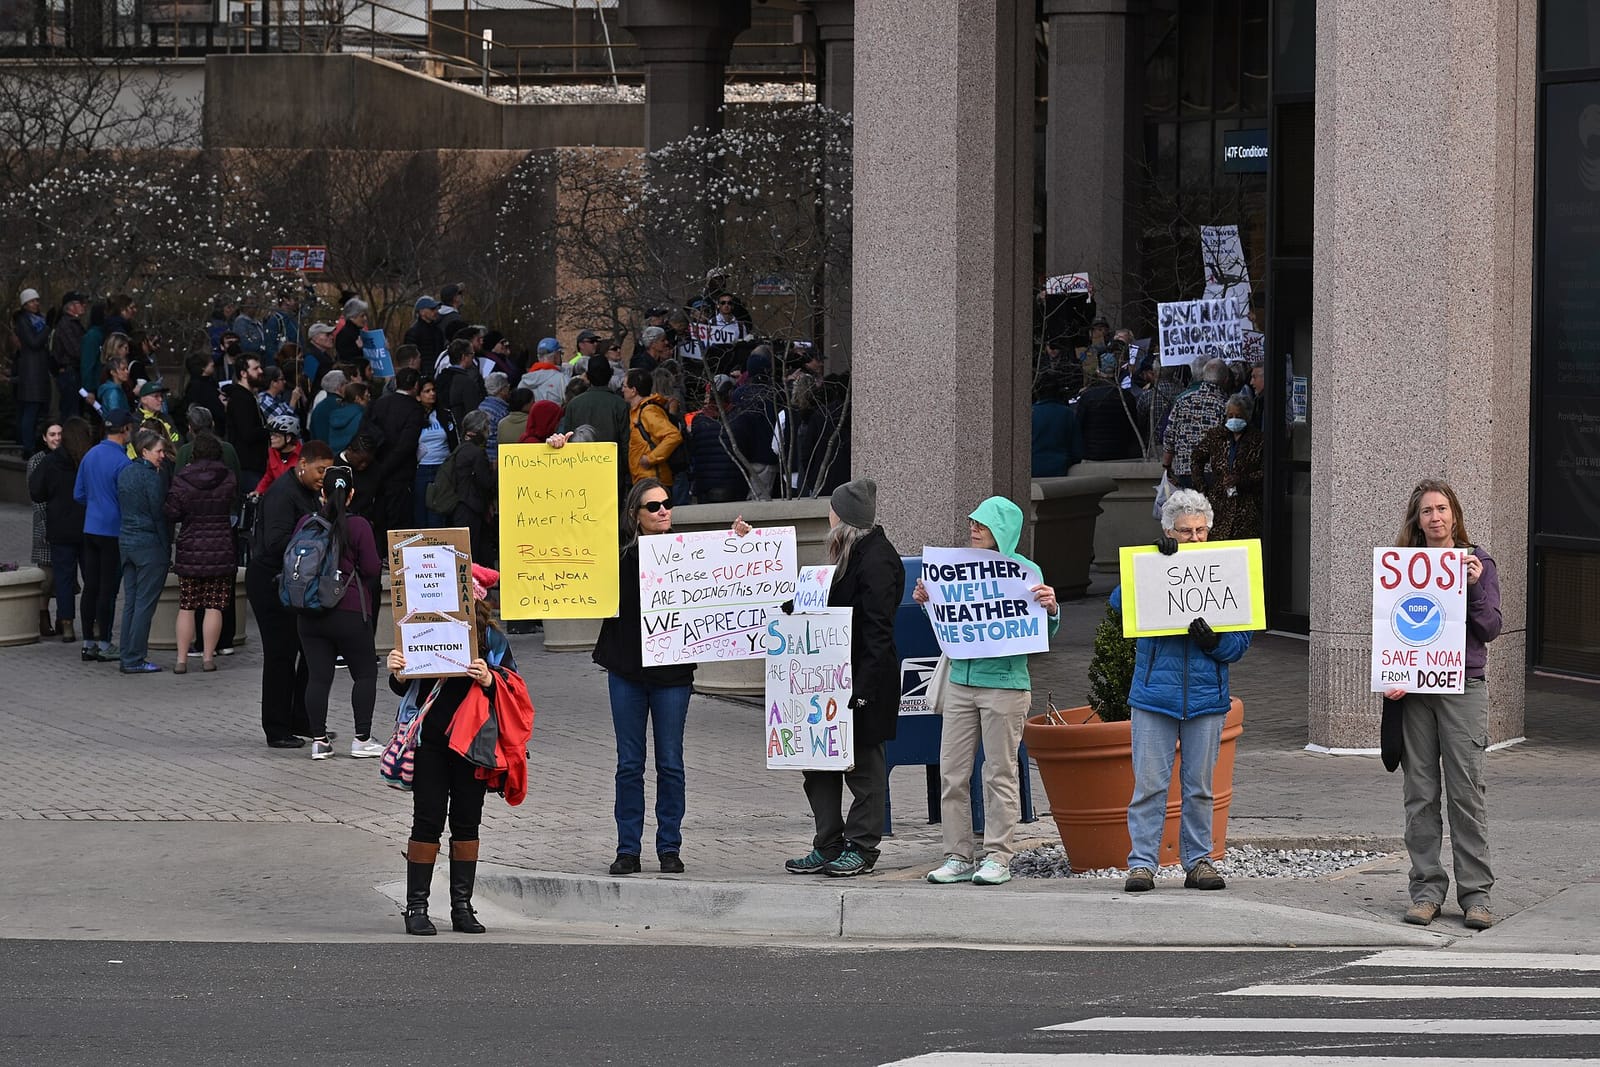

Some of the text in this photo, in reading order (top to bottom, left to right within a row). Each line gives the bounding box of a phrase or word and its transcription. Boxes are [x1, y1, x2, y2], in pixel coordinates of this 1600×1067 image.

[1161, 304, 1197, 328] SAVE
[714, 329, 735, 343] OUT
[1163, 323, 1242, 347] IGNORANCE
[1178, 345, 1195, 356] NOT
[1197, 345, 1203, 355] A
[517, 486, 587, 509] Making
[517, 511, 597, 528] Amerika
[516, 544, 596, 558] Russia
[651, 538, 783, 566] We're Sorry
[556, 571, 589, 581] NOAA
[665, 568, 708, 584] These
[711, 559, 784, 584] FUCKERS
[800, 570, 813, 584] WE
[922, 560, 1027, 582] TOGETHER,
[1166, 564, 1222, 586] SAVE
[1380, 551, 1464, 595] SOS!
[651, 590, 676, 608] ARE
[682, 583, 729, 605] DOING
[940, 580, 1005, 603] WE'LL
[1168, 586, 1238, 616] NOAA
[520, 595, 598, 612] Oligarchs
[933, 599, 1030, 623] WEATHER
[644, 609, 767, 646] WE APPRECIA
[934, 617, 1039, 644] THE STORM
[408, 643, 463, 652] EXTINCTION!
[1381, 649, 1462, 667] SAVE NOAA
[768, 658, 852, 695] ARE RISING
[1381, 670, 1463, 691] FROM DOGE!
[769, 694, 838, 726] AND SO
[767, 720, 849, 759] ARE WE!
